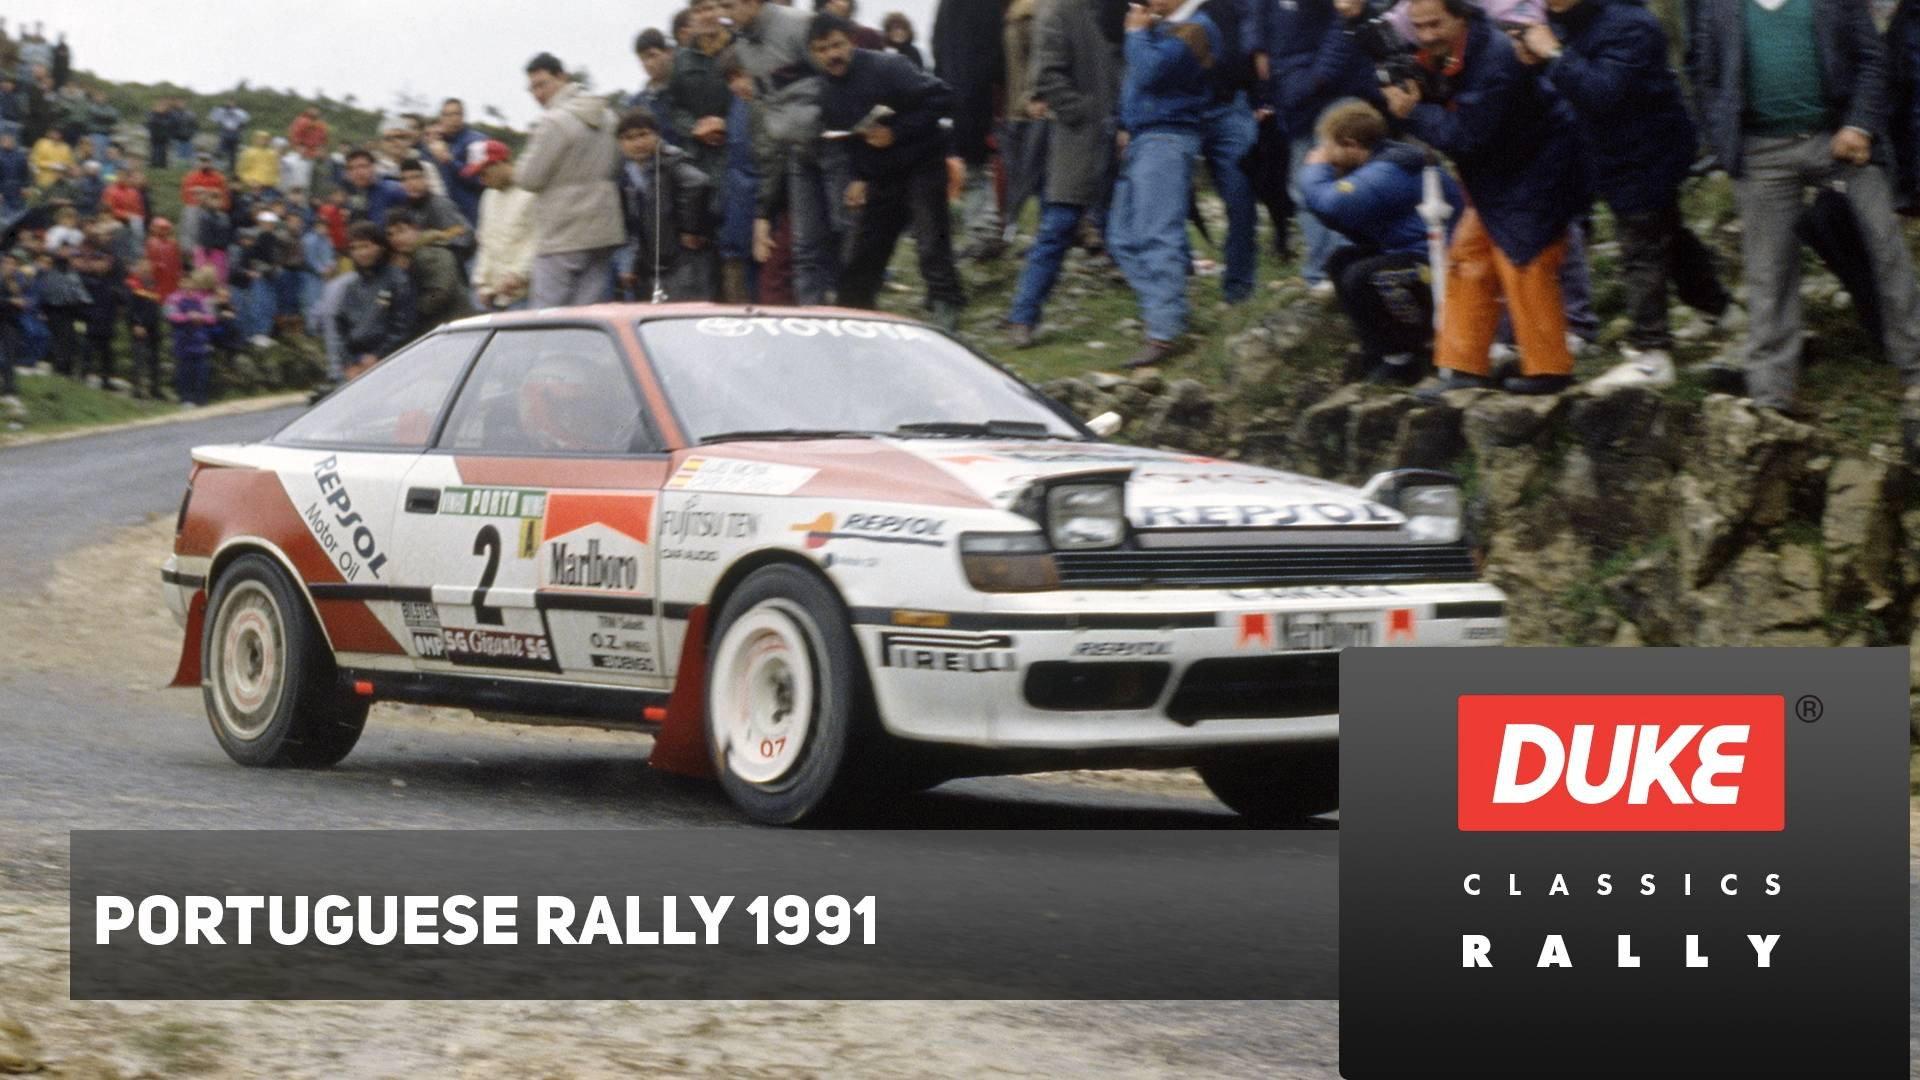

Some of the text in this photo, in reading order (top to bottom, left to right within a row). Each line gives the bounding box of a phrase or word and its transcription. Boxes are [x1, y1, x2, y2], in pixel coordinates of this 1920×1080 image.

[746, 317, 931, 342] TOYOTA
[313, 454, 388, 580] REPSOL
[470, 489, 519, 516] PORTO
[1138, 502, 1394, 526] REPSOL
[658, 494, 724, 544] FUJITSU
[842, 513, 946, 536] REPSOL
[305, 502, 360, 581] Motor Oil
[472, 523, 504, 625] 2
[549, 538, 638, 590] Marlboro
[414, 633, 445, 656] OMP
[445, 630, 552, 660] SG Gigante SG
[880, 632, 1018, 671] PIRELLI
[1070, 641, 1176, 656] REPSOL
